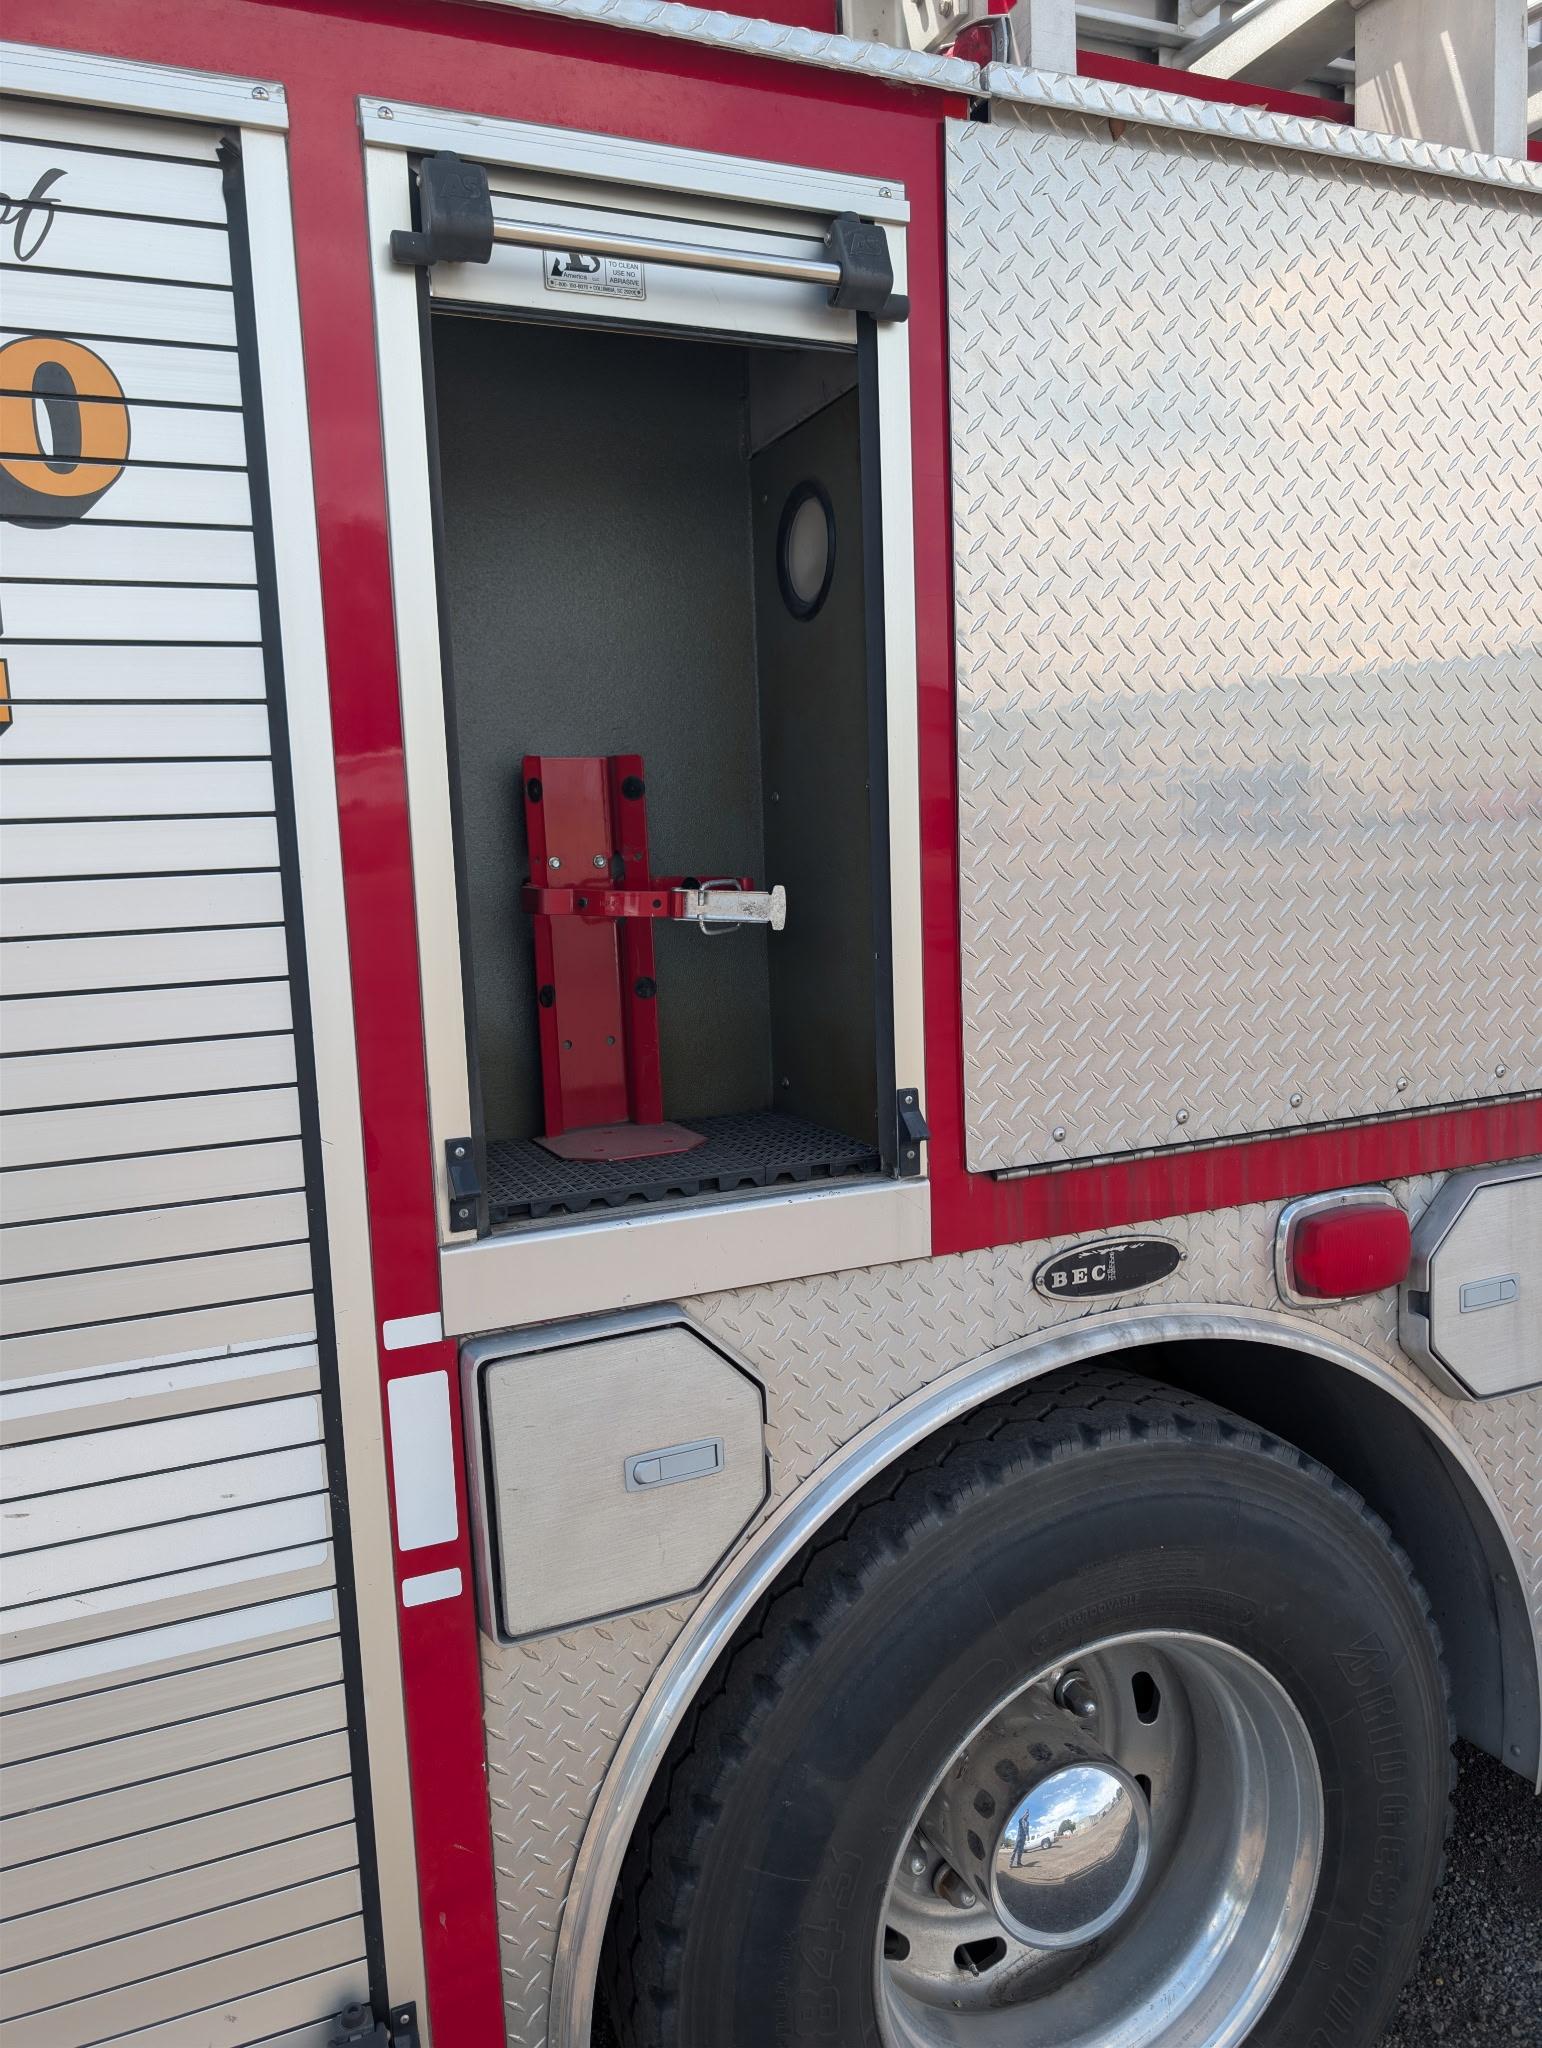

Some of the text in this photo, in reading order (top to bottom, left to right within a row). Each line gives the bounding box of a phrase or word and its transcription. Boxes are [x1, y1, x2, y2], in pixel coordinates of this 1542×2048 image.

[608, 260, 639, 271] TO CLEAN
[612, 269, 625, 277] USE
[609, 276, 640, 287] ABRASIVE
